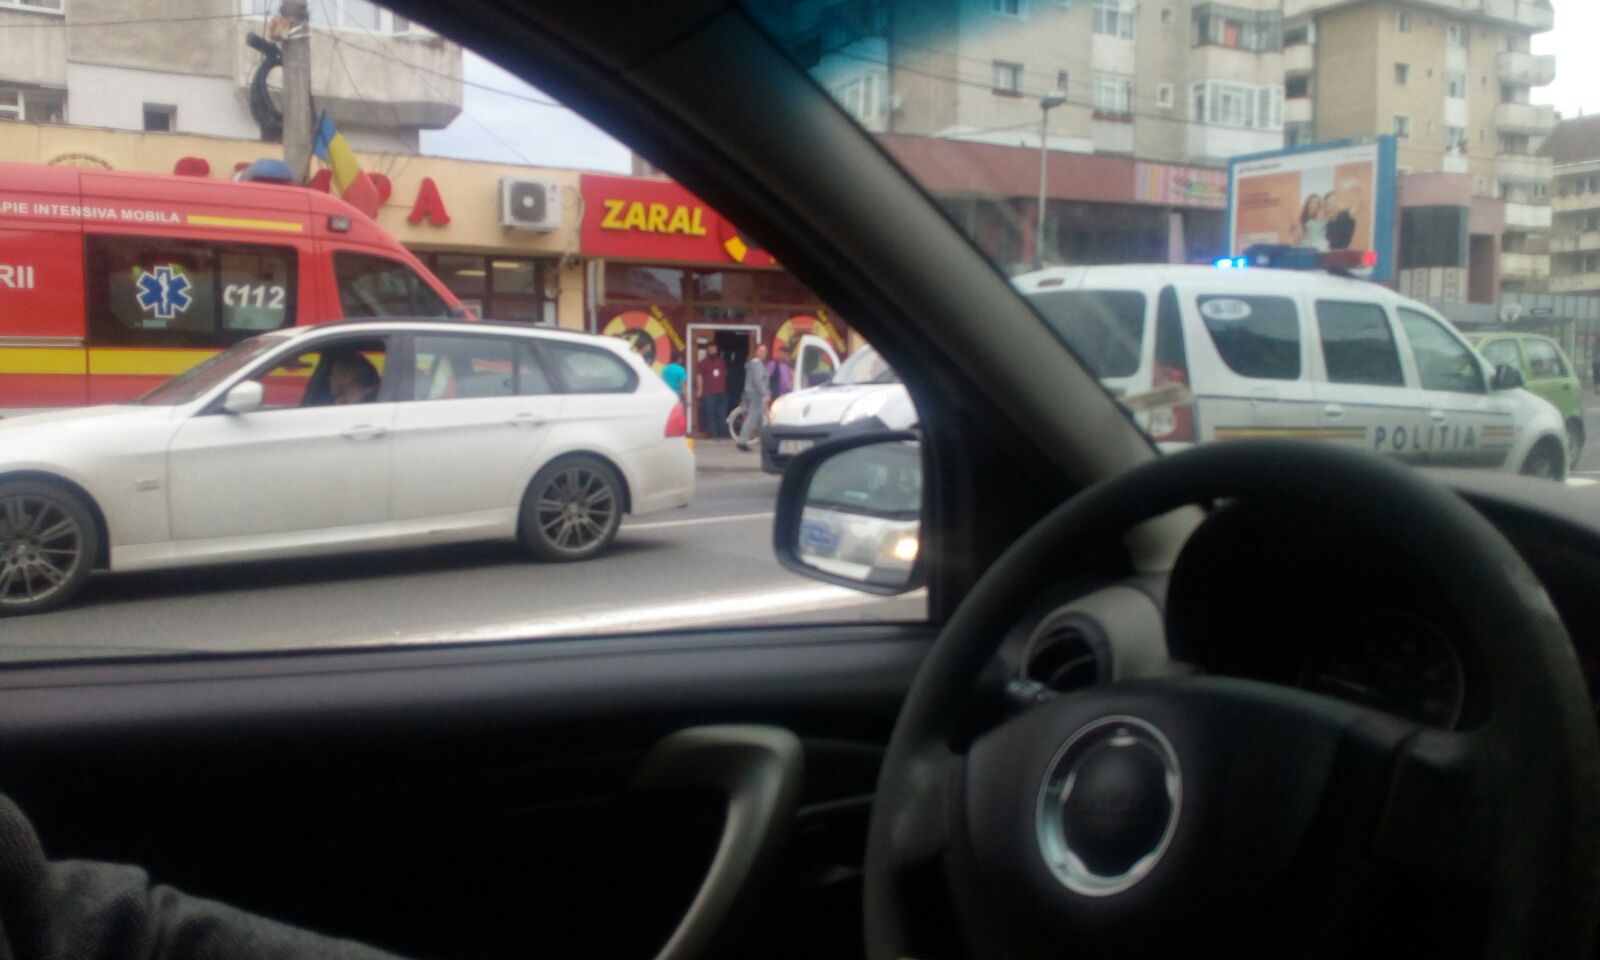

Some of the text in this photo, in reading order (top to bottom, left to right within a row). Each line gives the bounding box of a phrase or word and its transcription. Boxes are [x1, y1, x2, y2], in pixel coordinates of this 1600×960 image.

[33, 204, 118, 219] INTENSIVA
[121, 209, 180, 223] MOBILA
[600, 199, 706, 235] ZARAL
